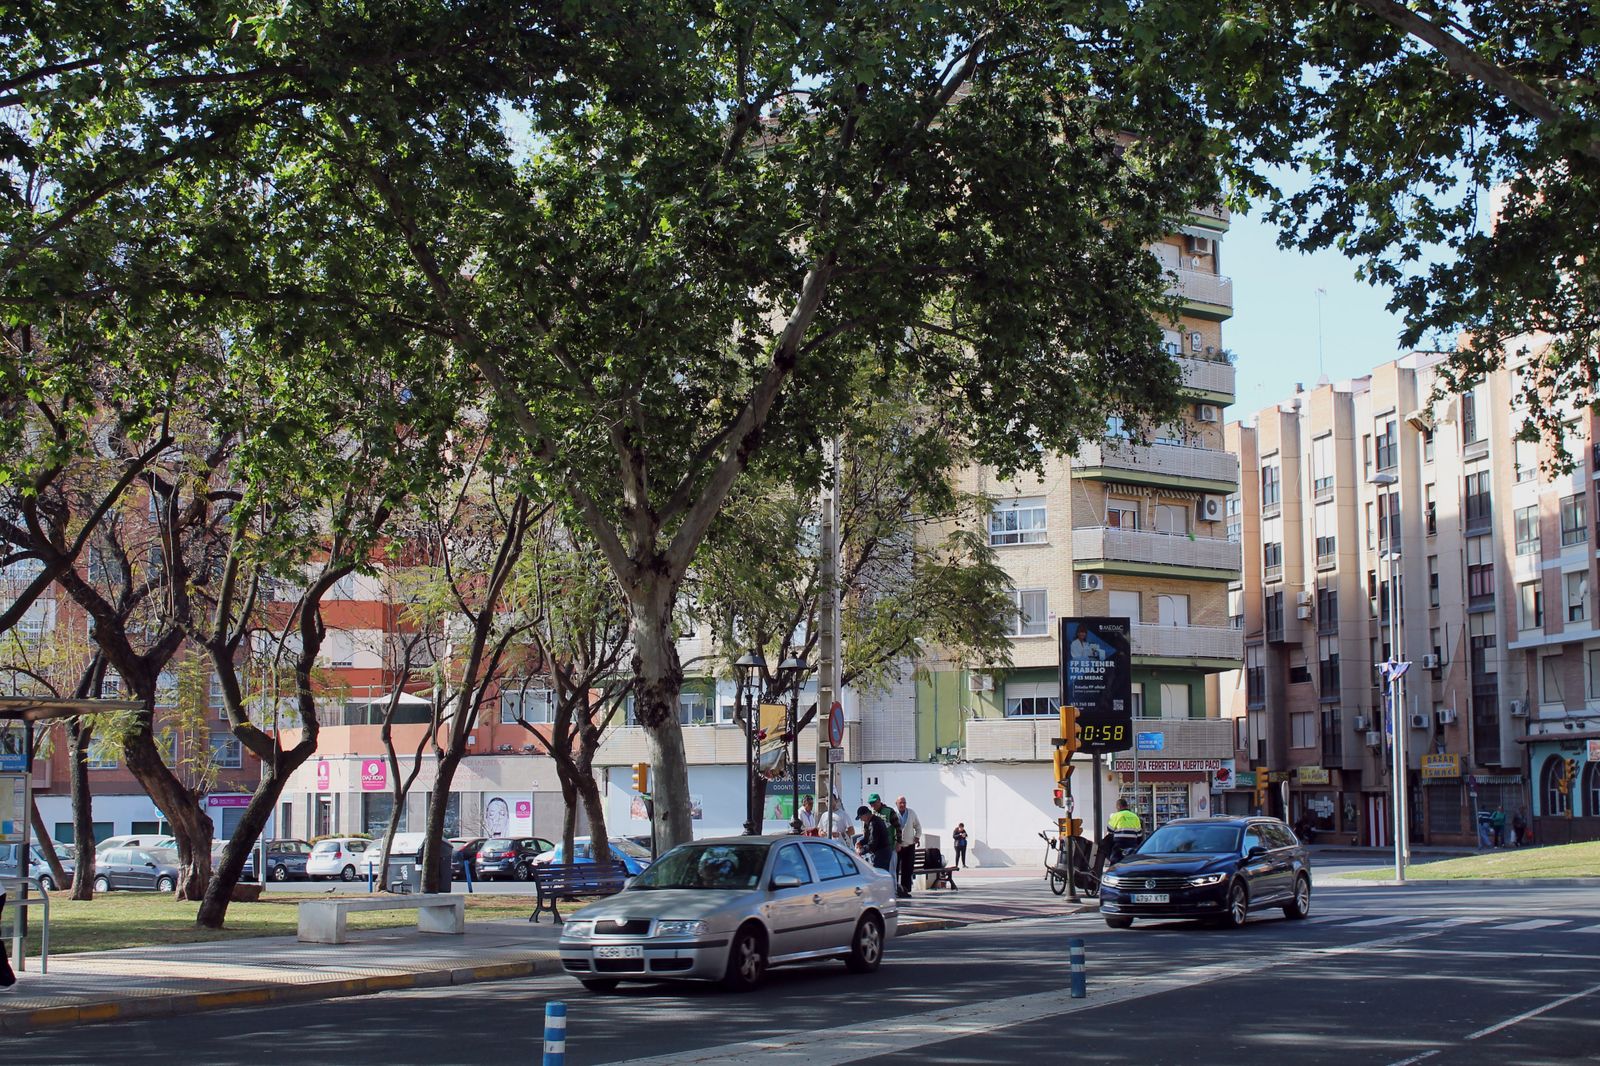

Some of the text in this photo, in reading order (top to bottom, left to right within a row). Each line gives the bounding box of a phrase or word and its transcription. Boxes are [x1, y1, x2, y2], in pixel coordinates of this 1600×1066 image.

[1115, 760, 1220, 771] DROGURIA FERRETERIA HUERTO PACO
